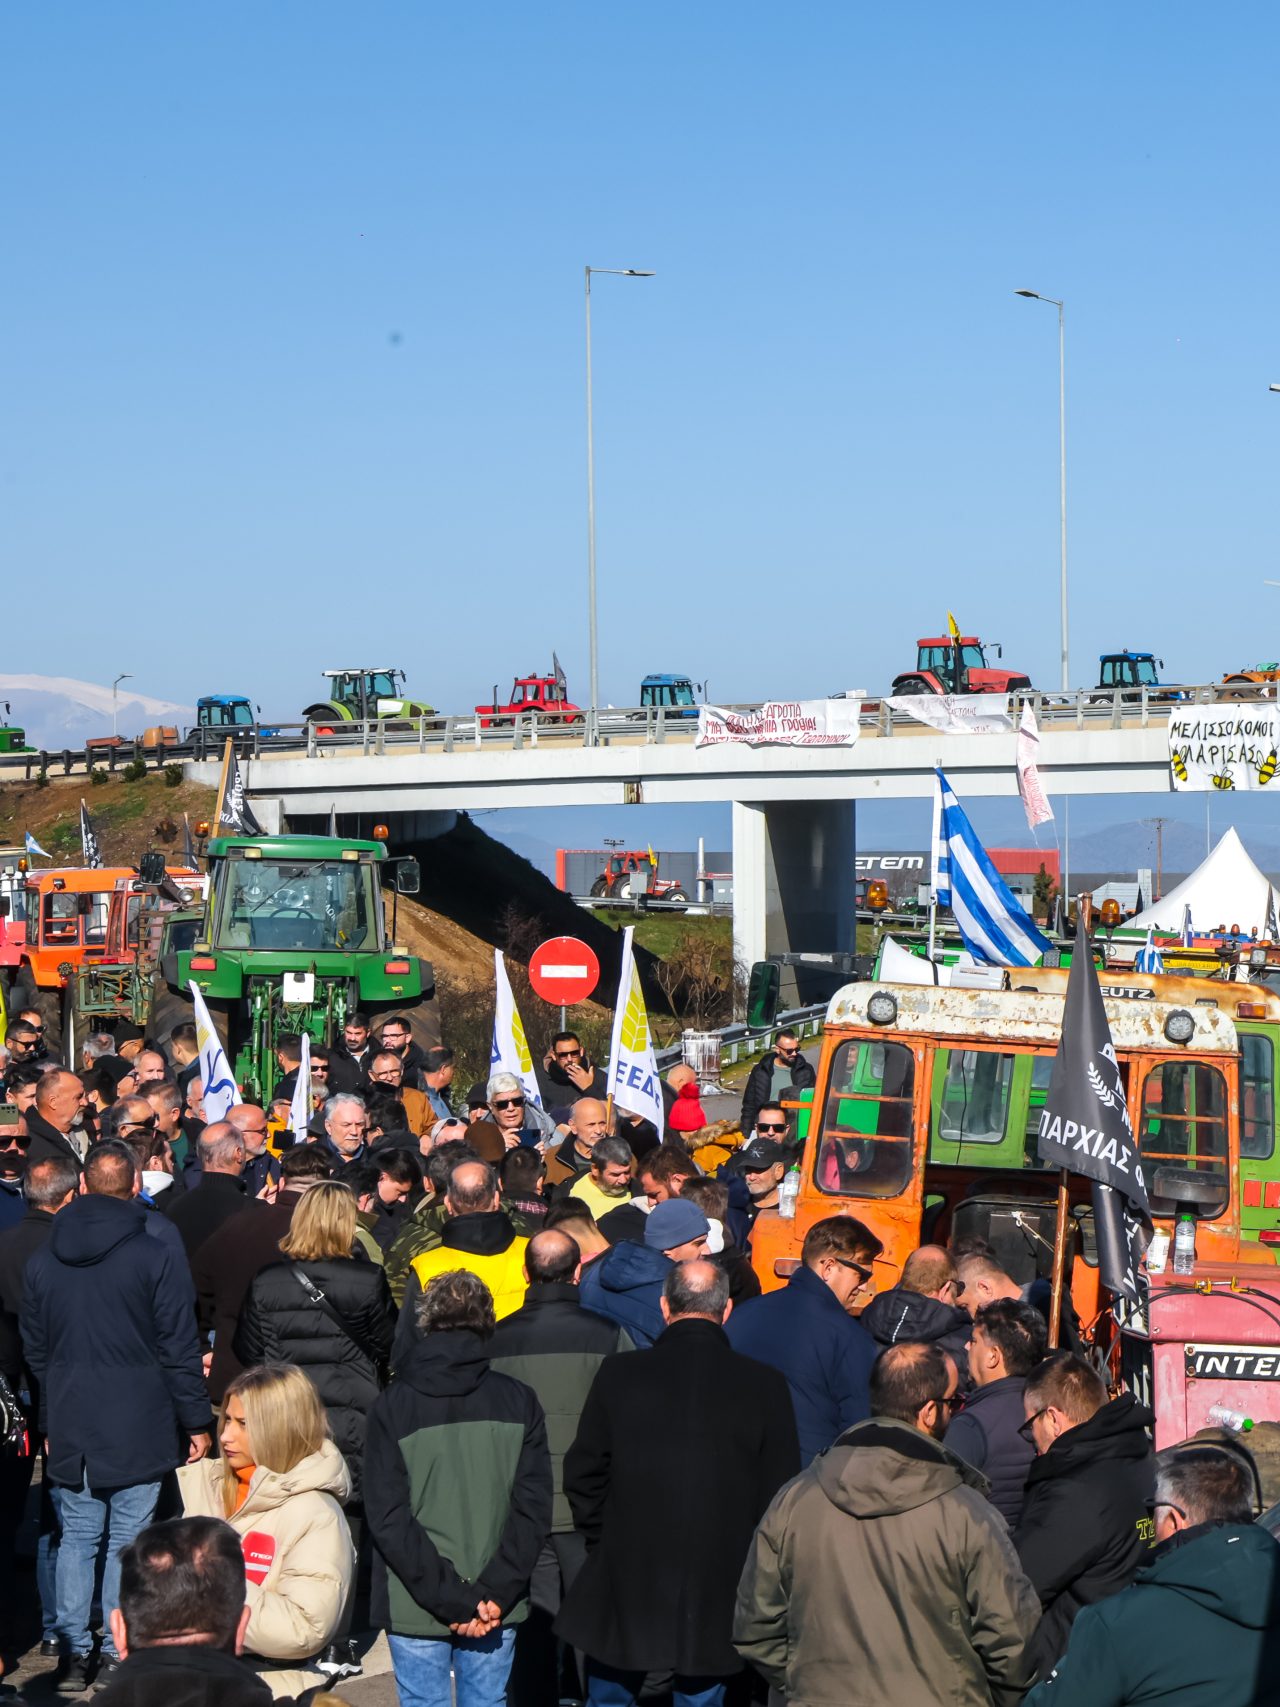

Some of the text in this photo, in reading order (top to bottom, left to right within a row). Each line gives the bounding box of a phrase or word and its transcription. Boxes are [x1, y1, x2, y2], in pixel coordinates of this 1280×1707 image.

[1170, 719, 1274, 740] ΜΕΛΙΣΣΟΚΟΜΟΙ
[1100, 987, 1151, 999] EUTZ
[1038, 1109, 1132, 1174] ΠΑΡΧΙΑΣ
